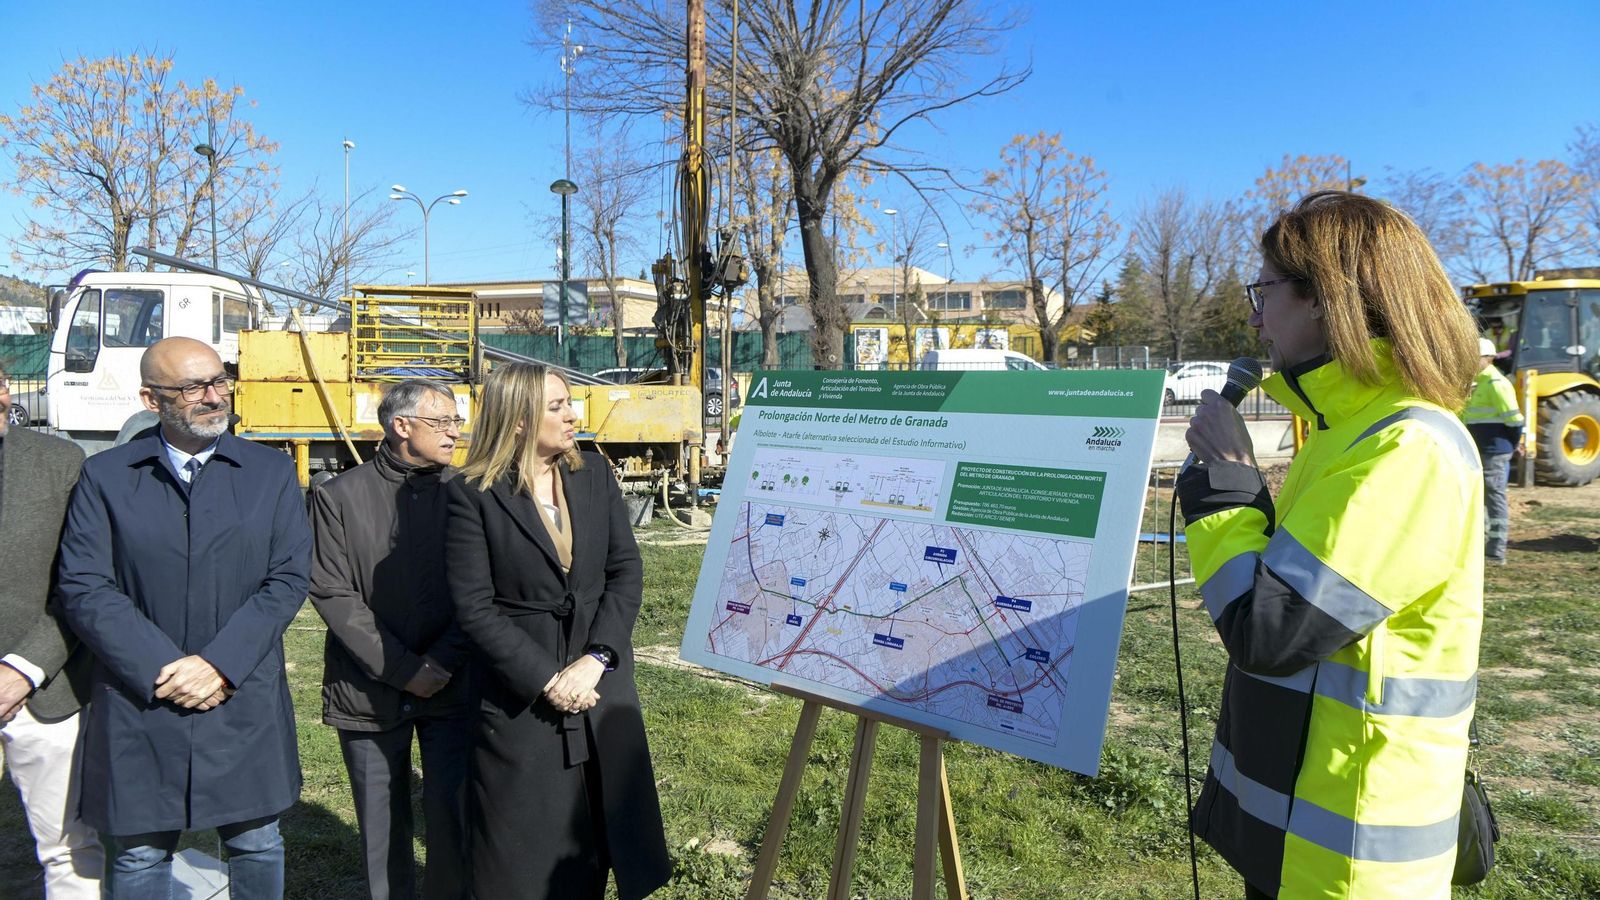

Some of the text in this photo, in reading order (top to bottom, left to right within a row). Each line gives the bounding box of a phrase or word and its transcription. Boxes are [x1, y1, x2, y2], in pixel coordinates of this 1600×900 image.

[178, 298, 191, 309] GR
[779, 389, 812, 398] Andalucía
[759, 410, 948, 427] Prolongación Norte del Metro de Granada
[753, 429, 777, 438] Albolote
[802, 432, 836, 442] (alternativa
[839, 435, 878, 444] seleccionada
[892, 438, 918, 447] Estudio
[920, 439, 966, 450] Informativo)
[1086, 438, 1121, 446] Andalucía
